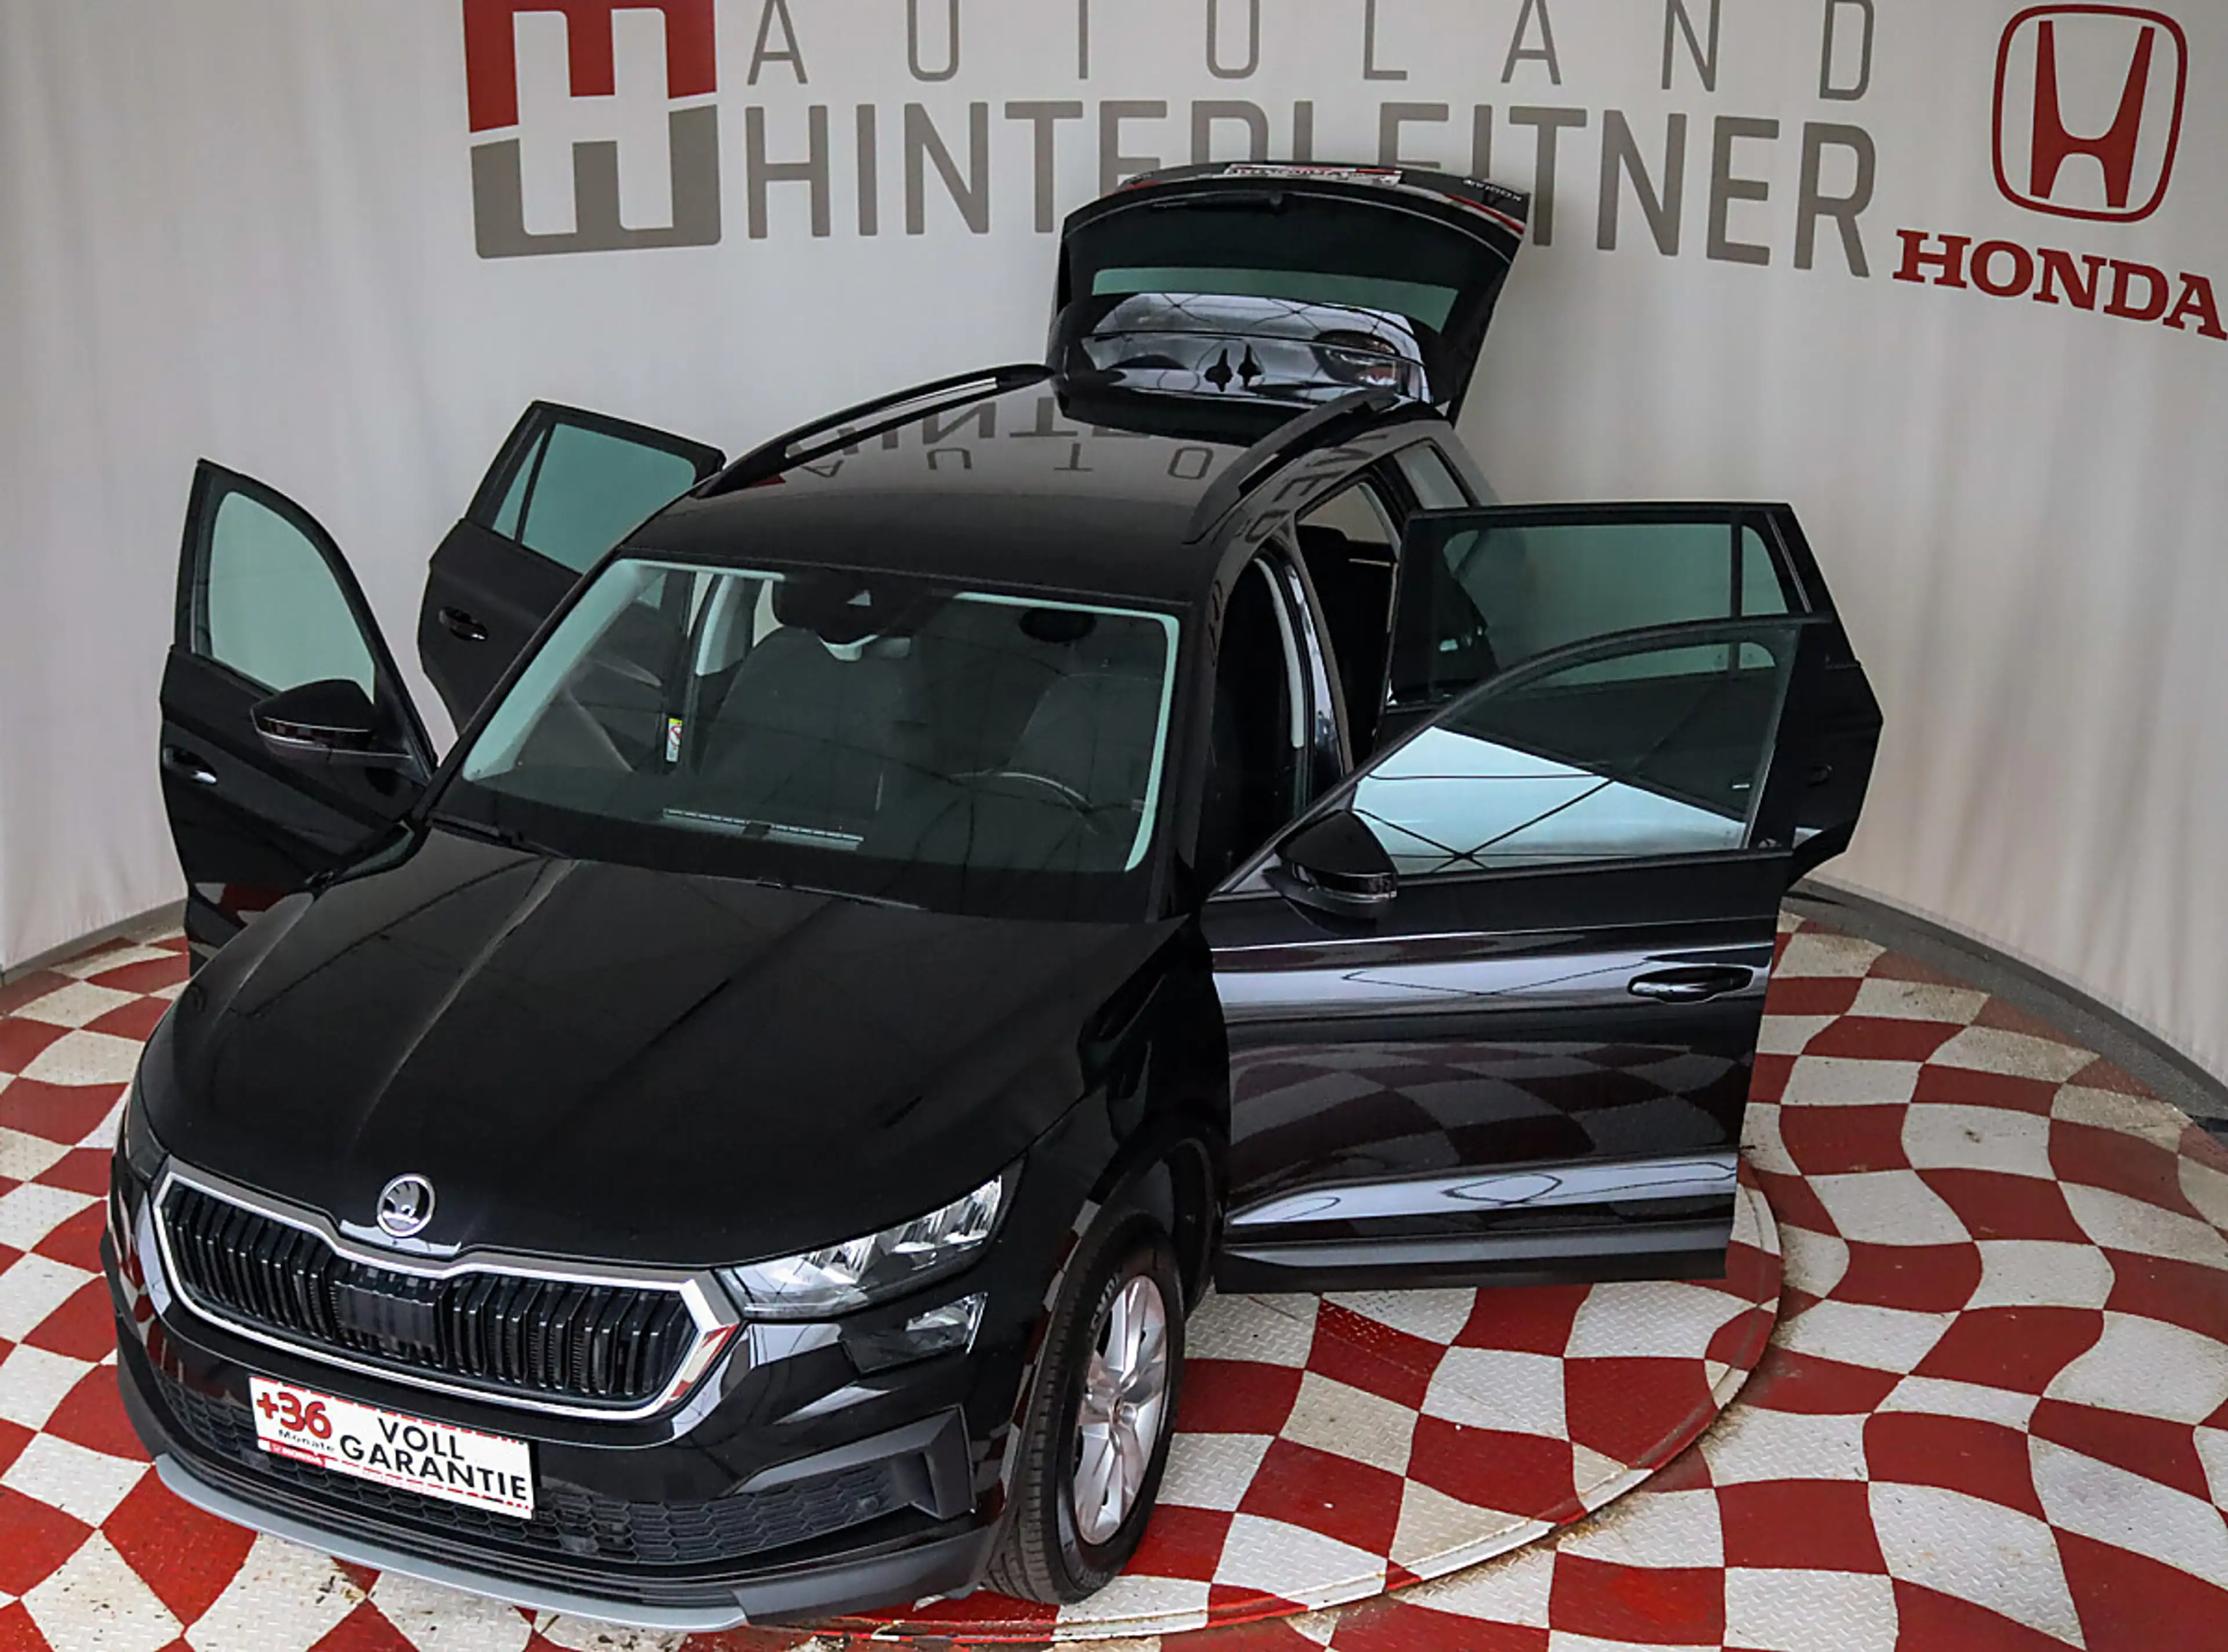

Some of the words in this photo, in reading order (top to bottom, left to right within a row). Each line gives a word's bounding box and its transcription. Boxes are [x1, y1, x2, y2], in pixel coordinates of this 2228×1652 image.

[745, 100, 1876, 278] HINTEEITNER
[1891, 229, 2227, 341] HONDA
[256, 1392, 332, 1439] +36
[278, 1429, 335, 1452] Monate
[378, 1416, 465, 1461] VOLL
[339, 1434, 527, 1501] GARANTIE
